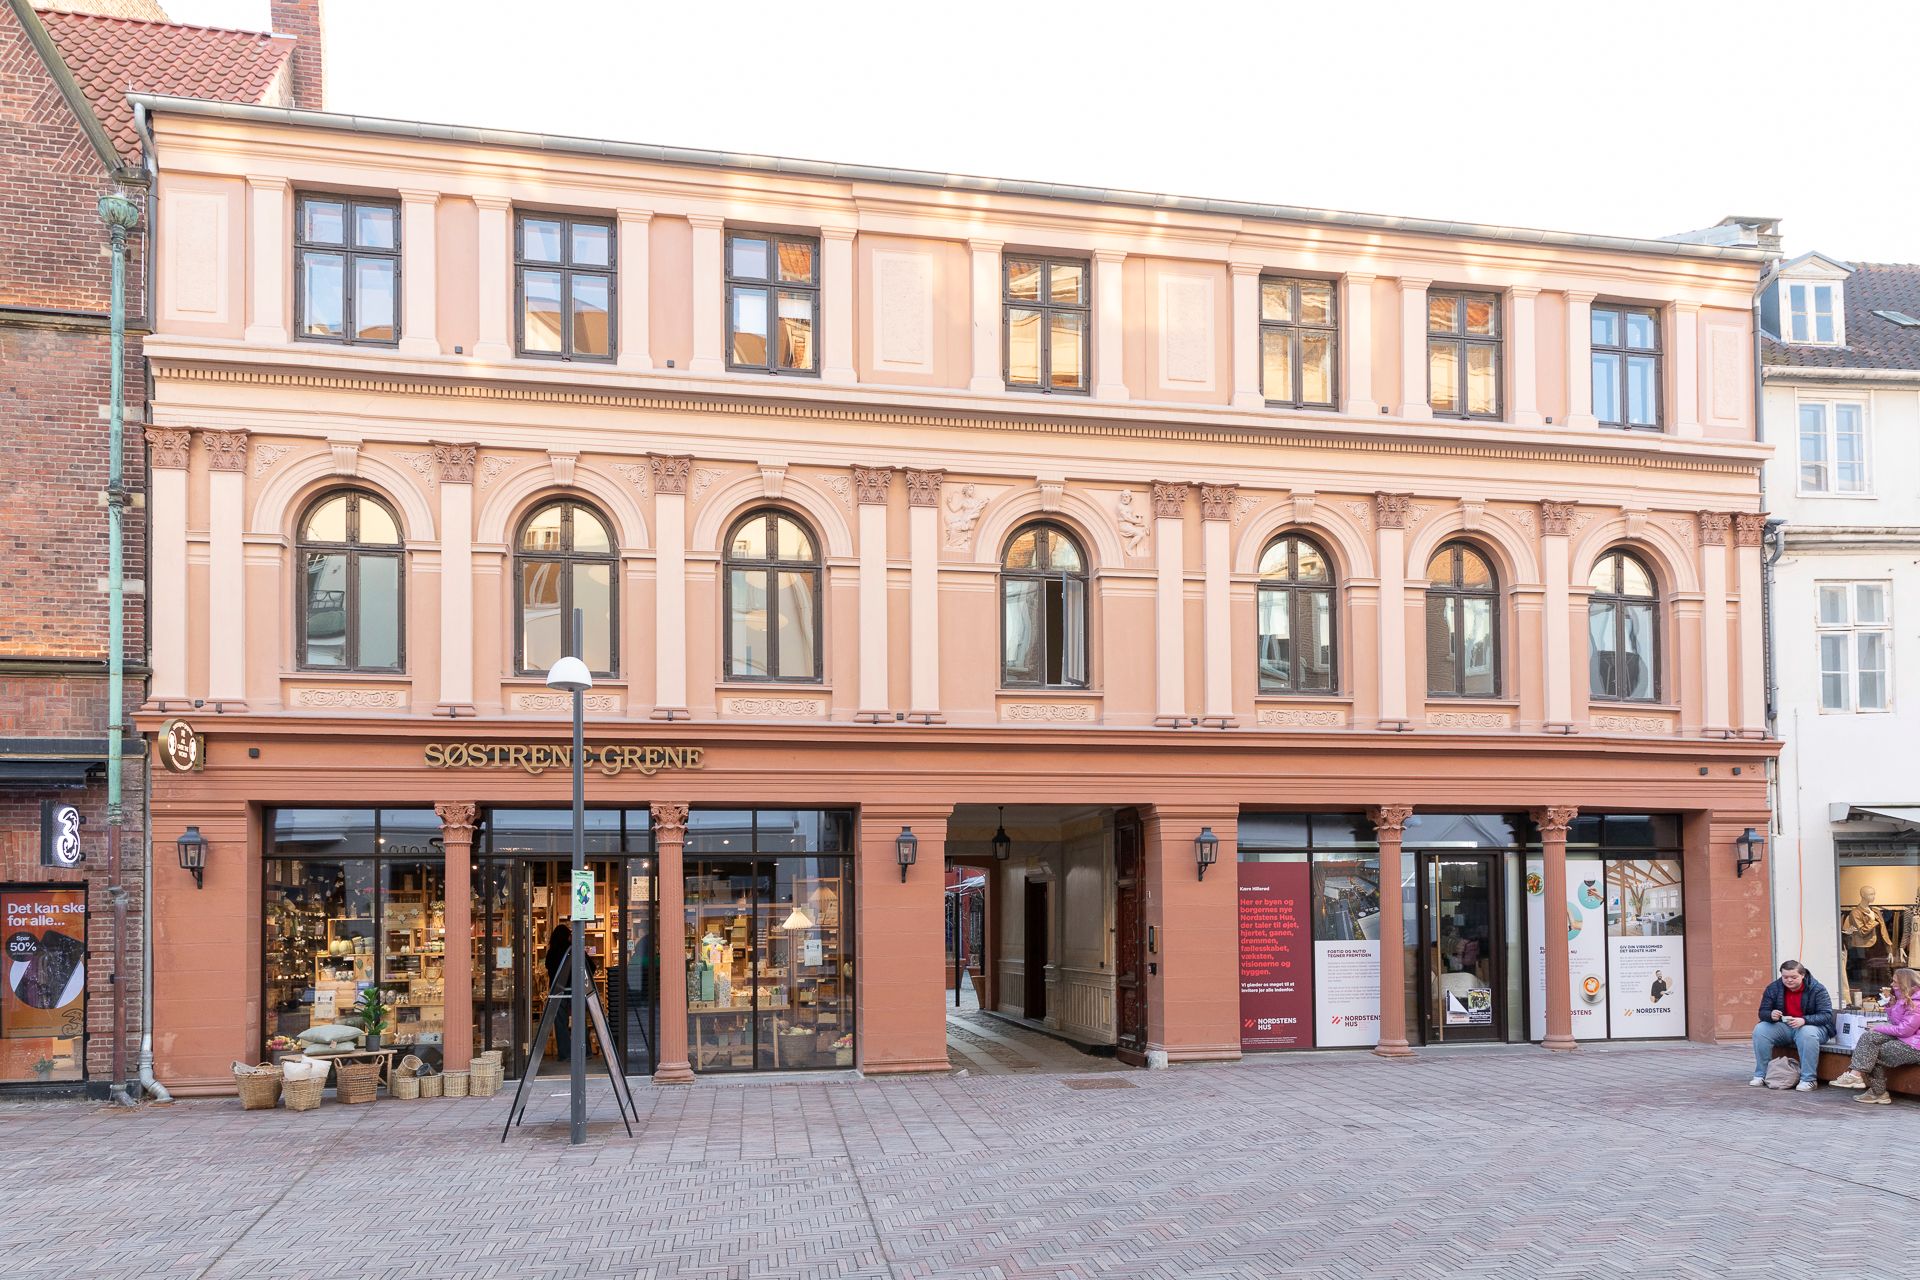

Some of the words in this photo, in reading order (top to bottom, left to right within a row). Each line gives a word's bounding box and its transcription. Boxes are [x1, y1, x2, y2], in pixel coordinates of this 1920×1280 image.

[600, 745, 704, 775] GRENE
[7, 903, 32, 914] Det
[34, 903, 59, 914] kan
[62, 902, 85, 913] ske
[7, 915, 28, 926] for
[30, 915, 65, 926] alle...
[10, 942, 37, 952] 50%
